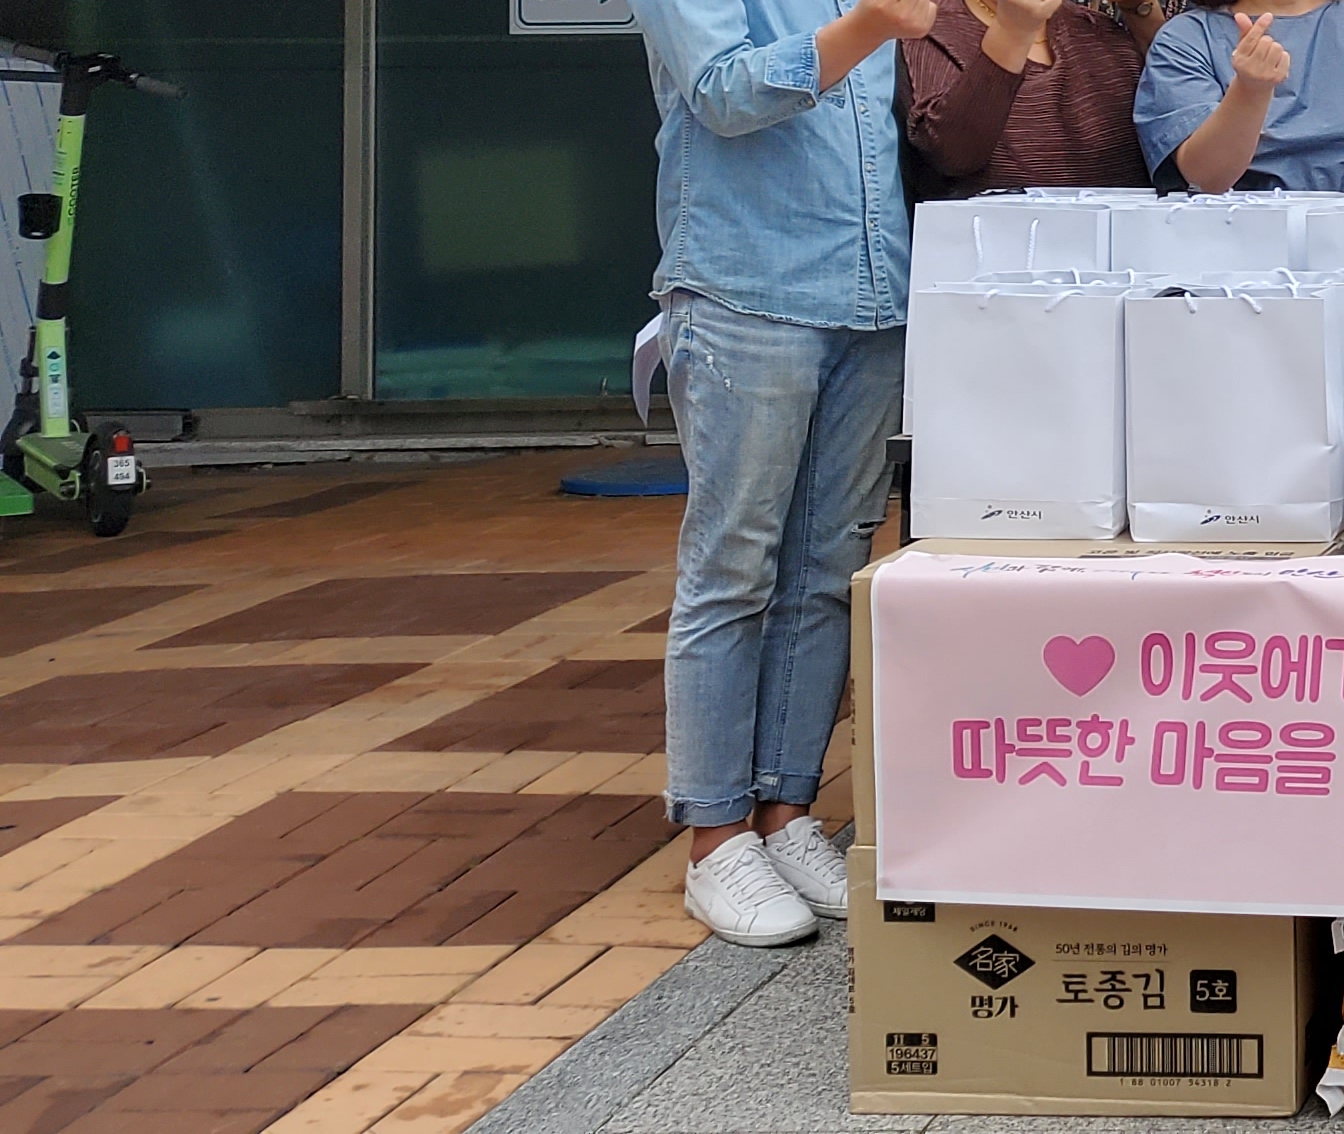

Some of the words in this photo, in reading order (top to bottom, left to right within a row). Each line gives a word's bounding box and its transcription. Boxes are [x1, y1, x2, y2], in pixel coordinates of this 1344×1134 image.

[1007, 509, 1042, 521] 안산시
[1225, 514, 1260, 525] 안산시
[952, 713, 1135, 788] 따뜻한
[1150, 720, 1339, 799] 마음을
[1056, 943, 1081, 955] 50년
[1083, 943, 1117, 956] 전통의
[1120, 943, 1143, 956] 김의
[1145, 943, 1168, 956] 명가
[969, 946, 1020, 978] 名家
[1056, 968, 1166, 1010] 토종김
[1196, 980, 1232, 1002] 5호
[971, 995, 1019, 1019] 명가
[889, 1048, 936, 1060] 196437
[891, 1063, 933, 1074] 5세트입
